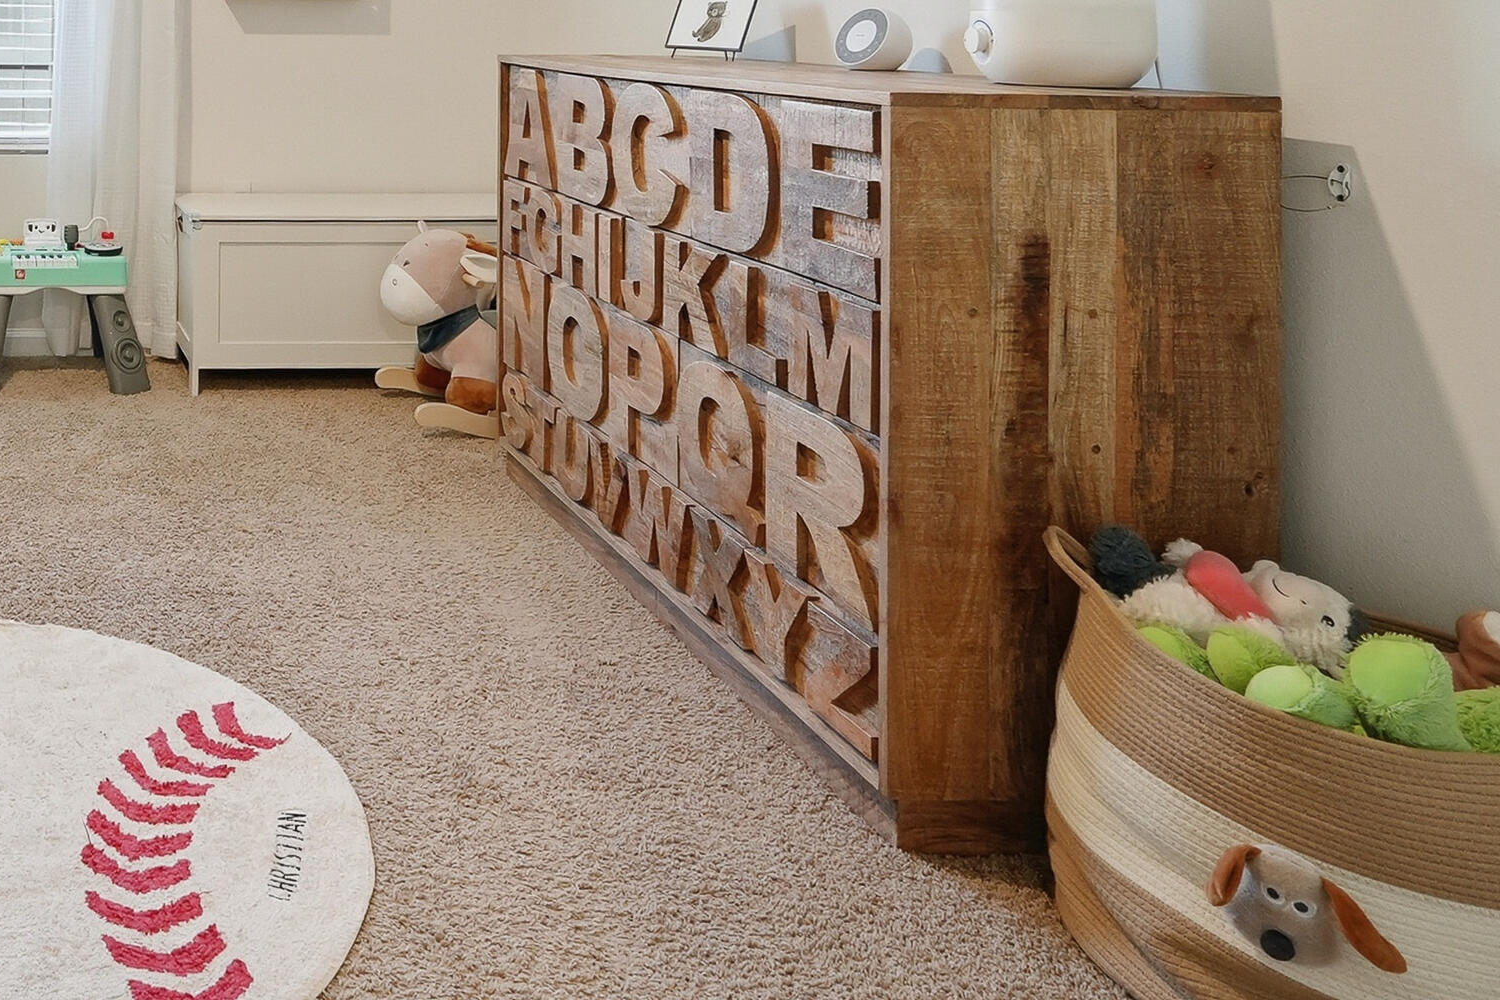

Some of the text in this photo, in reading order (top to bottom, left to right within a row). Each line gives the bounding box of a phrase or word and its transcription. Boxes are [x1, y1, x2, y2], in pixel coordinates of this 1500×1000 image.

[502, 178, 880, 433] FGHIJKLM
[504, 66, 881, 302] ABCDE
[502, 254, 879, 633] NOPQR
